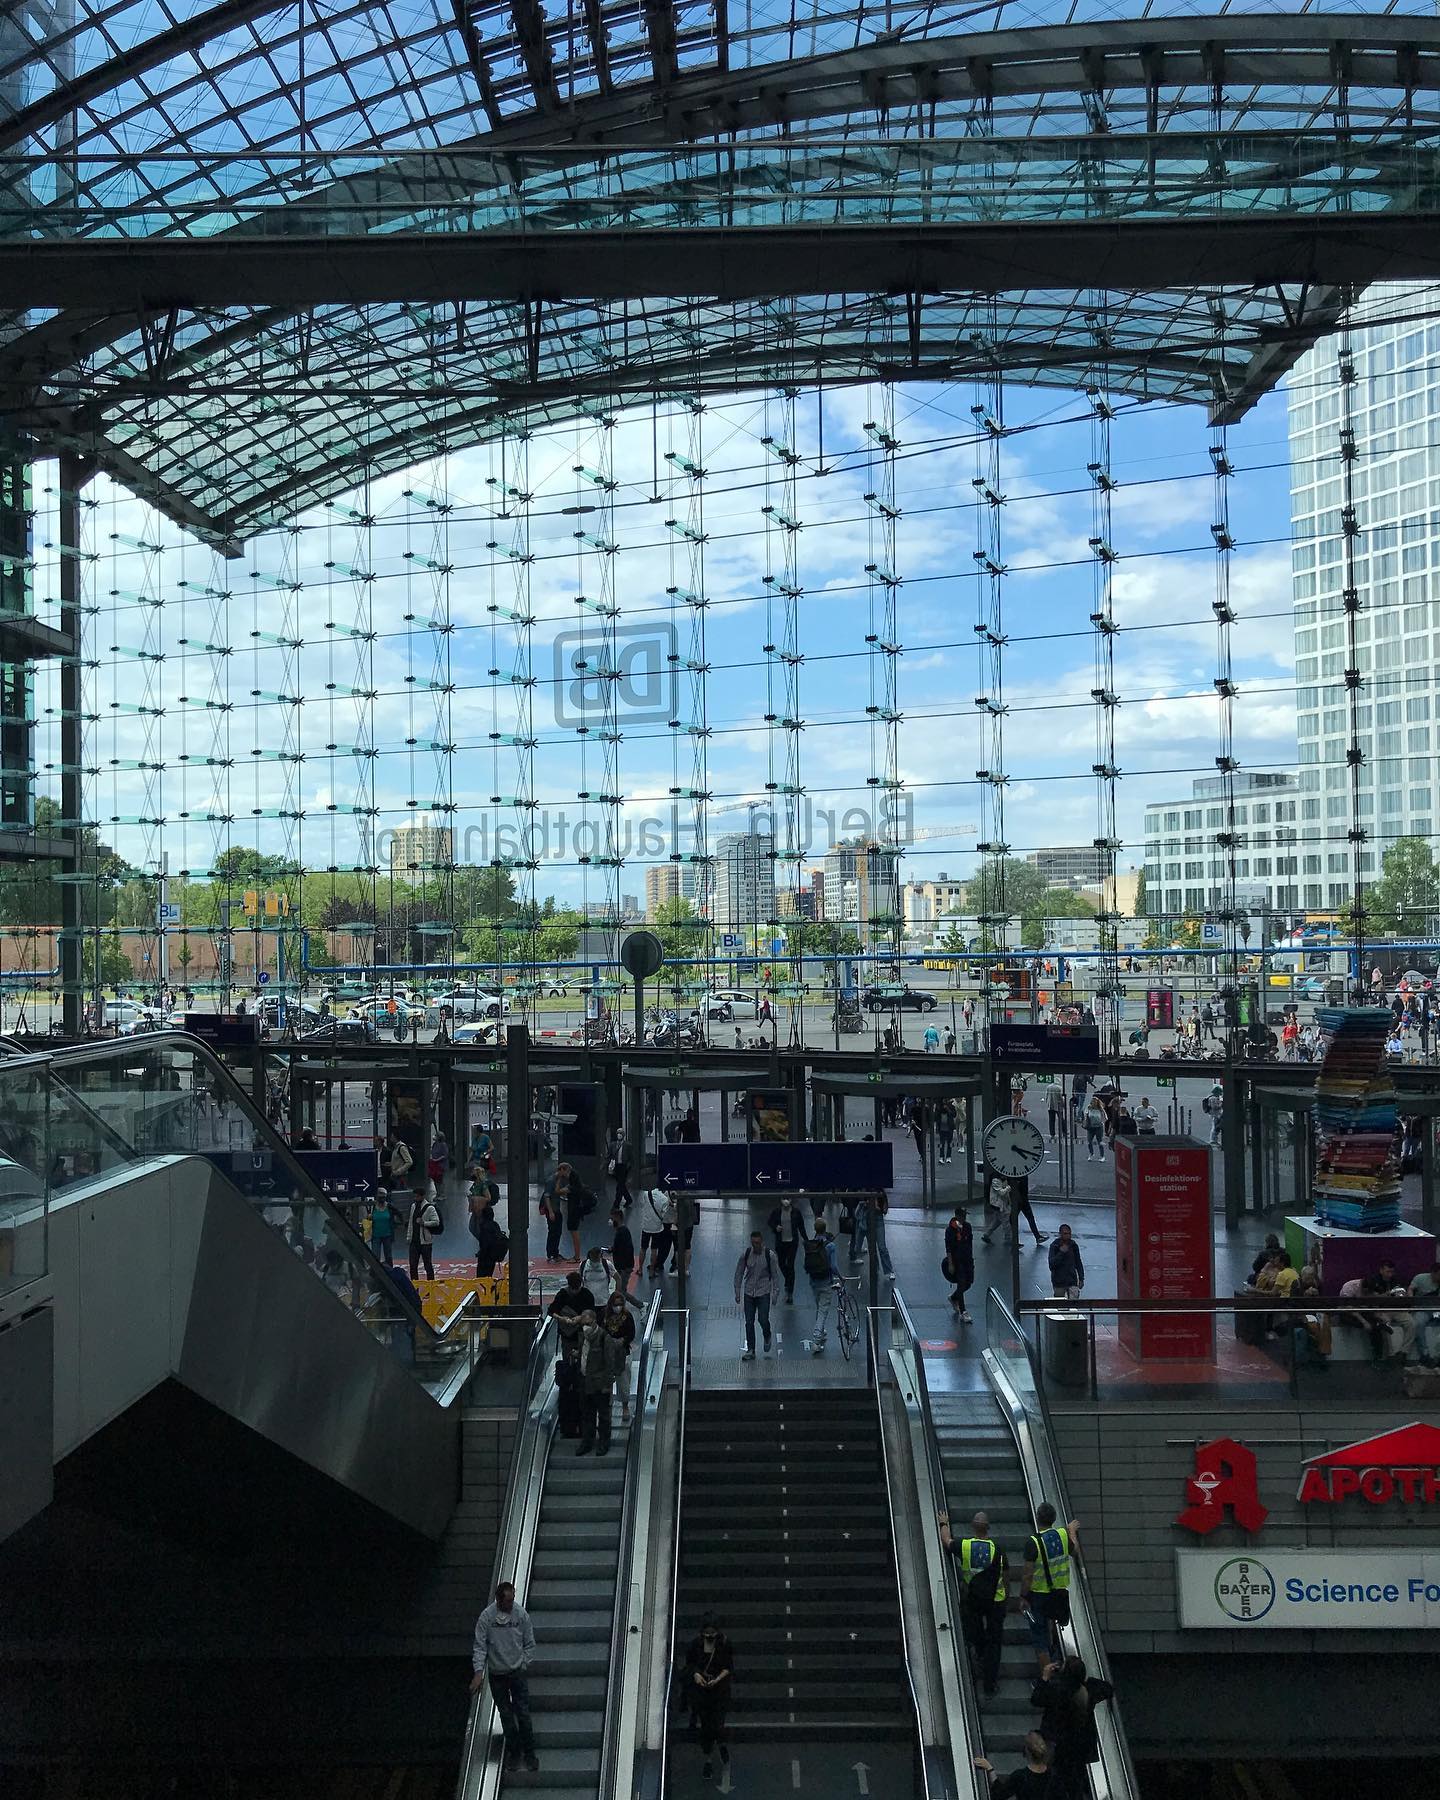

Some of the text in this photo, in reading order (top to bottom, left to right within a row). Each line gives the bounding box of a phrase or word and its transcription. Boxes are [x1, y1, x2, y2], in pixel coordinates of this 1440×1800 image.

[685, 1177, 696, 1185] WC
[1144, 1174, 1202, 1183] Desinfektions-
[1159, 1184, 1188, 1192] station
[1219, 1584, 1271, 1596] BAYER
[1285, 1577, 1440, 1603] Science Fo
